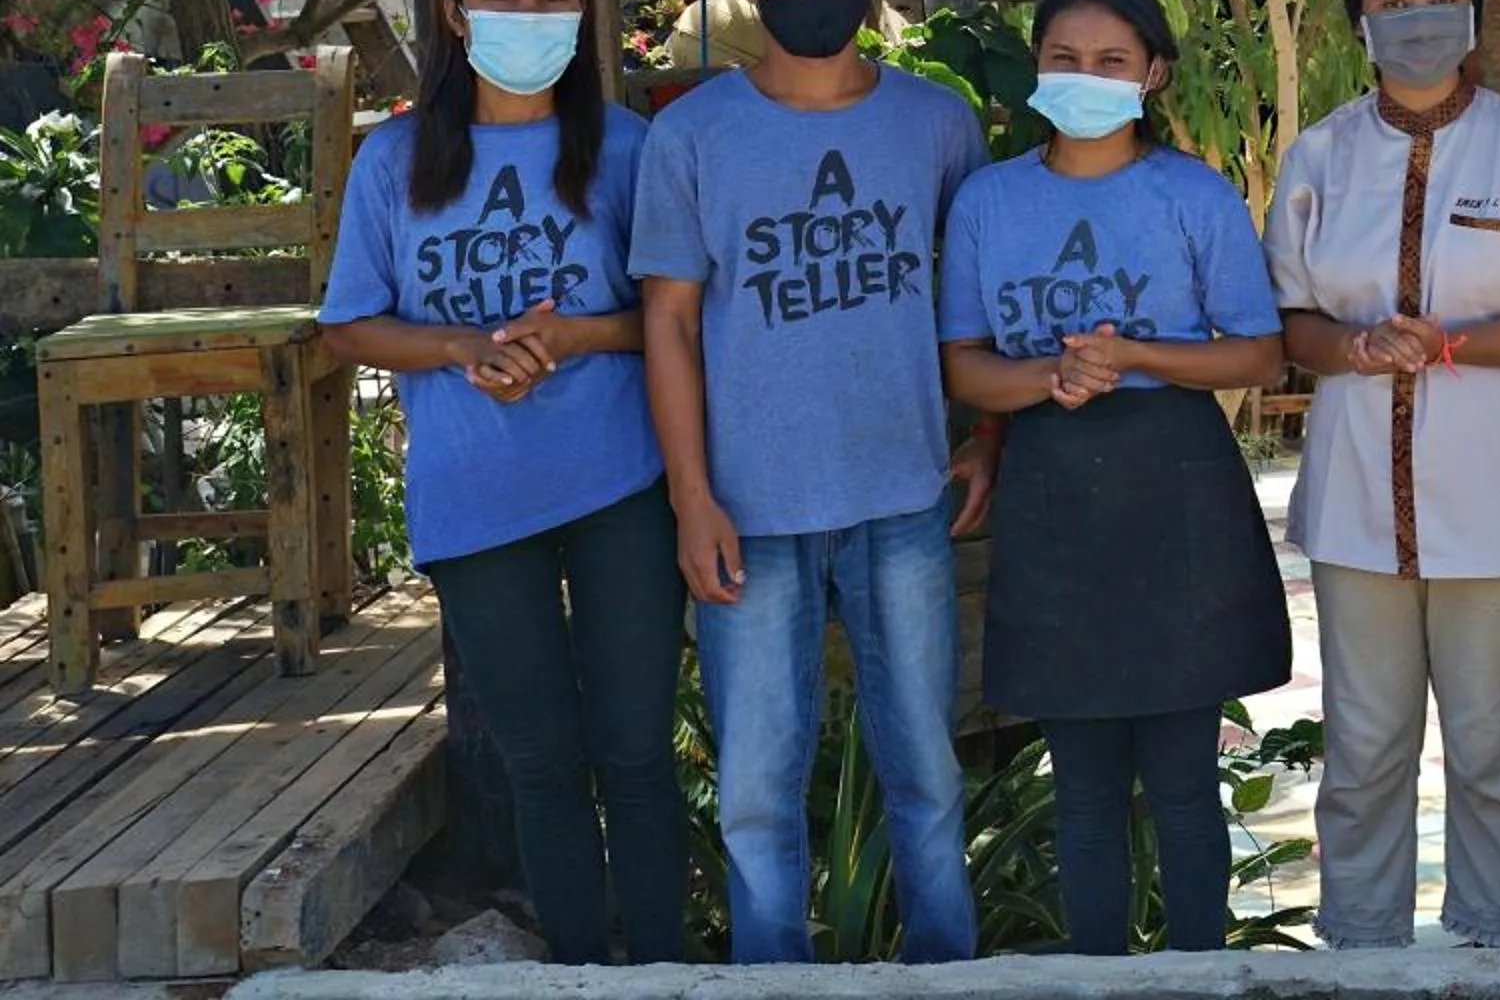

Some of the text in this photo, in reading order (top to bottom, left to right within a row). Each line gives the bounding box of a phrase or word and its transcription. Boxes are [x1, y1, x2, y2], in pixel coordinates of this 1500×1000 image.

[477, 164, 525, 226] A
[809, 149, 855, 210] A
[416, 214, 577, 283] STORY
[746, 199, 906, 266] STORY
[1053, 219, 1098, 273] A
[742, 252, 921, 330] TELLER
[997, 267, 1152, 325] STORY
